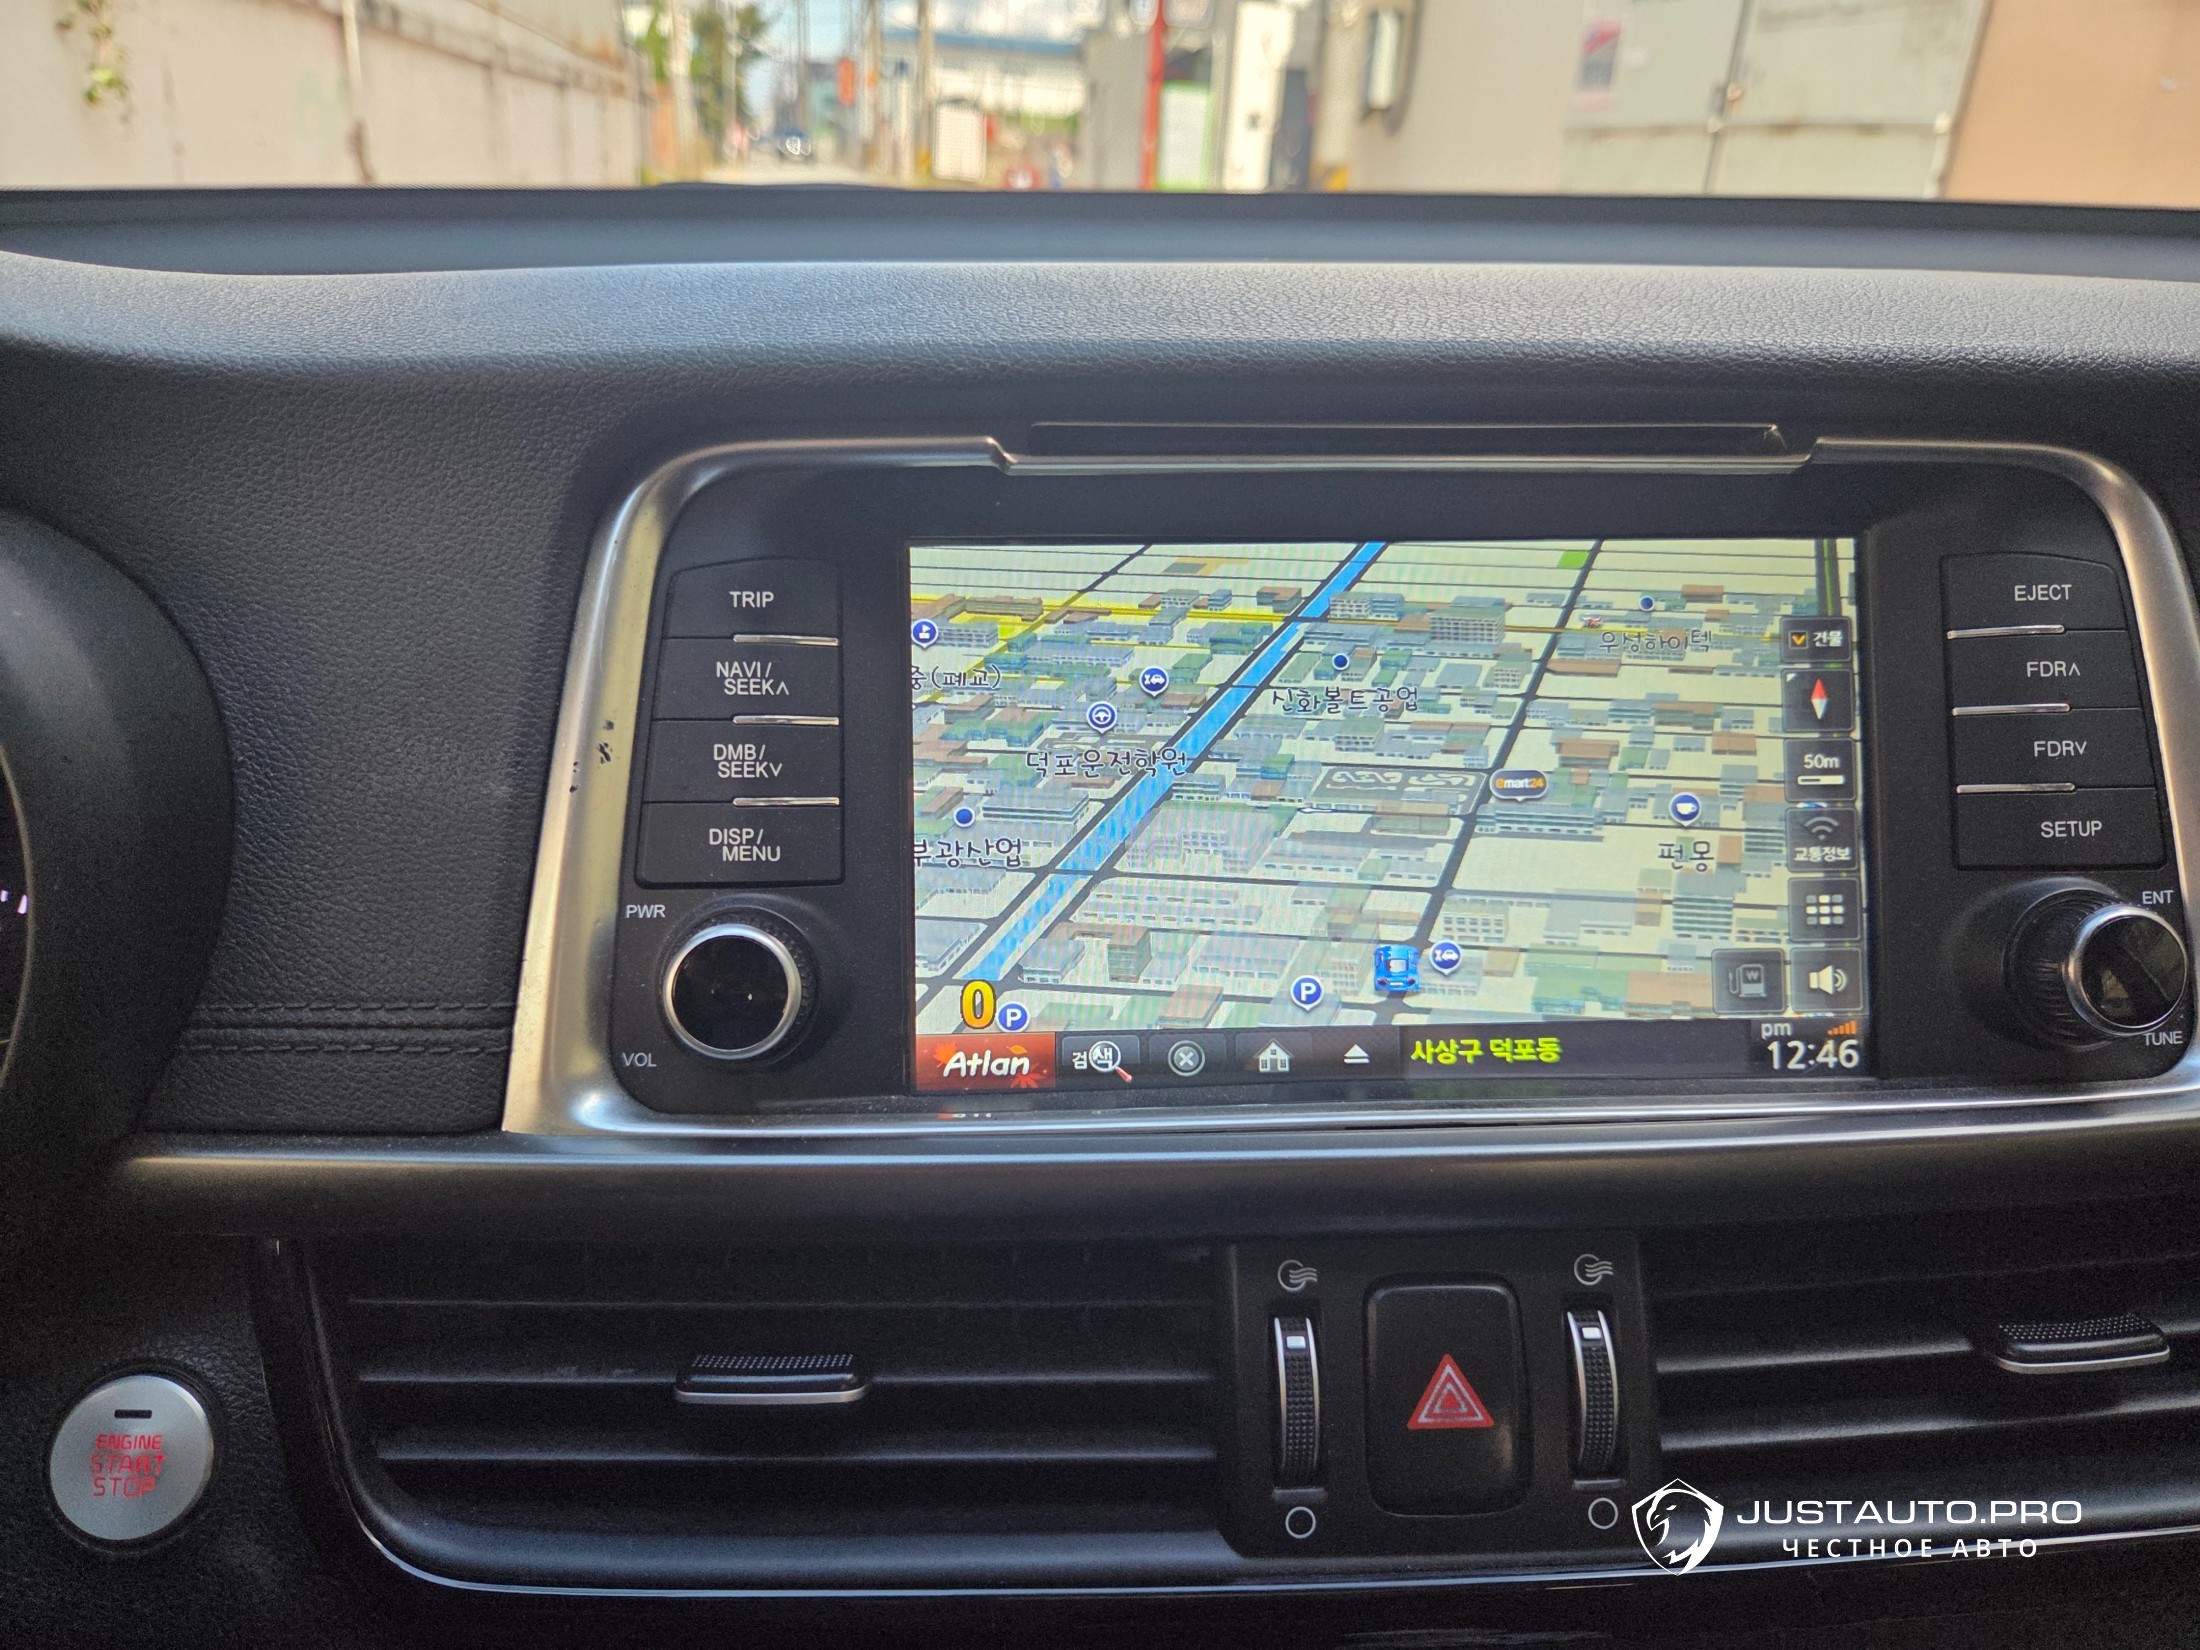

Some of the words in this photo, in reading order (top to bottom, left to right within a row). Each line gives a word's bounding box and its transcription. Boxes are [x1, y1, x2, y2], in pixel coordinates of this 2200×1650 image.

[729, 591, 774, 608] TRIP
[2014, 584, 2072, 601] EJECT
[1599, 629, 1712, 653] 우성하이텍
[1812, 630, 1844, 647] 건물
[716, 661, 772, 678] NAVI/
[1272, 686, 1419, 714] 신화볼트공업
[713, 744, 766, 761] DMB/
[1026, 748, 1187, 778] 덕포운전학원
[1803, 754, 1840, 769] 50m
[708, 828, 764, 845] DISP/
[2040, 821, 2103, 838] SETUP
[722, 846, 781, 862] MENU
[1657, 840, 1715, 872] 펀몽
[1794, 846, 1851, 862] 교통정보
[2142, 890, 2174, 905] ENT
[625, 904, 666, 919] PWR
[961, 980, 996, 1029] 0
[1761, 1022, 1792, 1040] pm
[2143, 1031, 2184, 1047] TUNE
[1072, 1045, 1114, 1070] 검색
[1410, 1039, 1484, 1064] 사상구
[1489, 1037, 1563, 1063] 덕포동
[1767, 1039, 1860, 1070] 12:46
[622, 1052, 657, 1067] VOL
[943, 1049, 1030, 1077] Atlan
[95, 1433, 163, 1450] ENGINE
[89, 1453, 167, 1475] START
[92, 1476, 157, 1498] STOP
